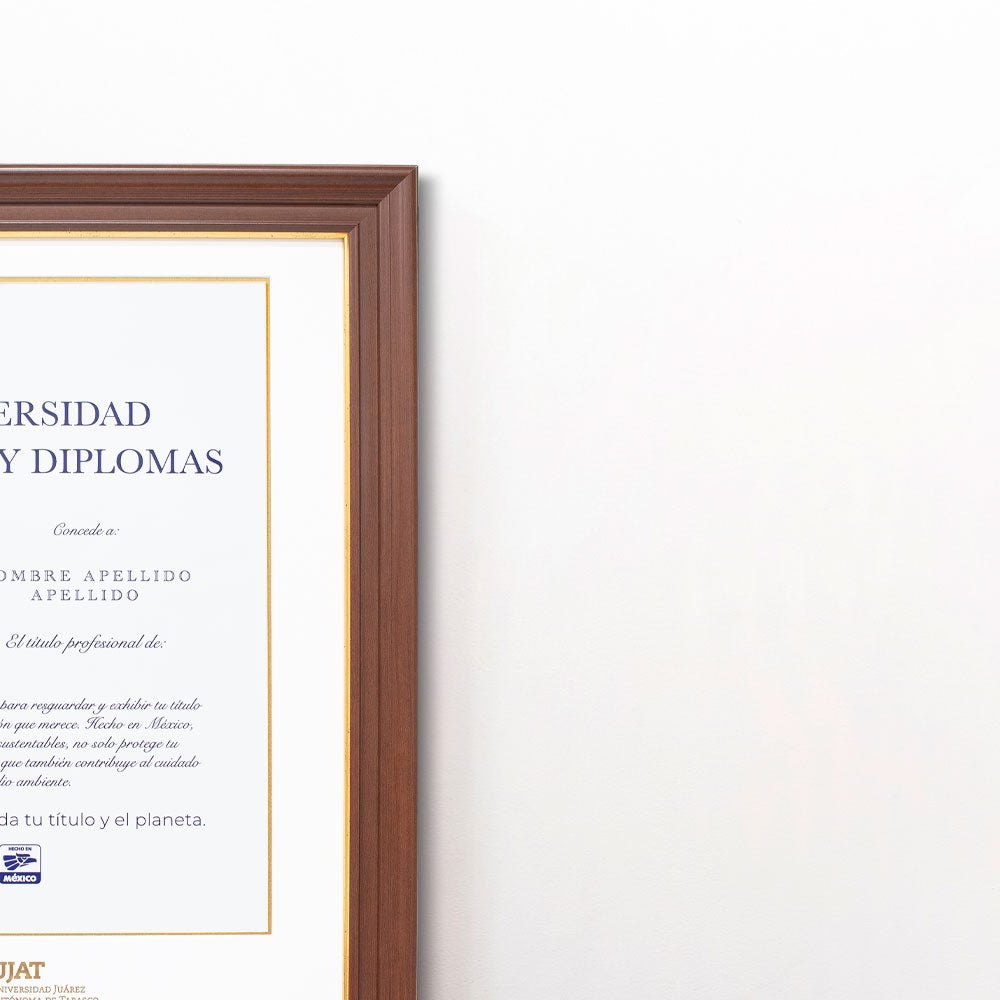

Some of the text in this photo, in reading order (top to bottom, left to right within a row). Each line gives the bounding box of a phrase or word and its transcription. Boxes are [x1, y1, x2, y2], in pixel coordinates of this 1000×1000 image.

[31, 448, 224, 475] DIPLOMAS
[53, 522, 120, 536] Concede a:
[84, 570, 192, 582] APELLIDO
[30, 589, 139, 601] APELLIDO
[5, 634, 166, 654] El título profesional de:
[31, 698, 96, 714] resguardar
[93, 702, 107, 714] y
[110, 698, 152, 710] exhibir
[154, 701, 168, 710] tu
[170, 698, 202, 710] título
[14, 721, 36, 734] que
[38, 721, 80, 729] merece.
[84, 717, 126, 729] Hecho
[127, 721, 142, 729] en
[145, 717, 193, 731] México,
[91, 736, 117, 748] solo
[115, 738, 163, 753] protege
[166, 739, 180, 748] tu
[0, 759, 23, 772] que
[24, 755, 73, 767] también
[75, 755, 137, 772] contribuye
[139, 755, 154, 767] al
[154, 755, 201, 767] cuidado
[16, 774, 71, 787] ambiente.
[24, 814, 43, 826] tu
[49, 812, 95, 826] título
[99, 815, 110, 829] y
[115, 812, 129, 826] el
[136, 812, 206, 829] planeta.
